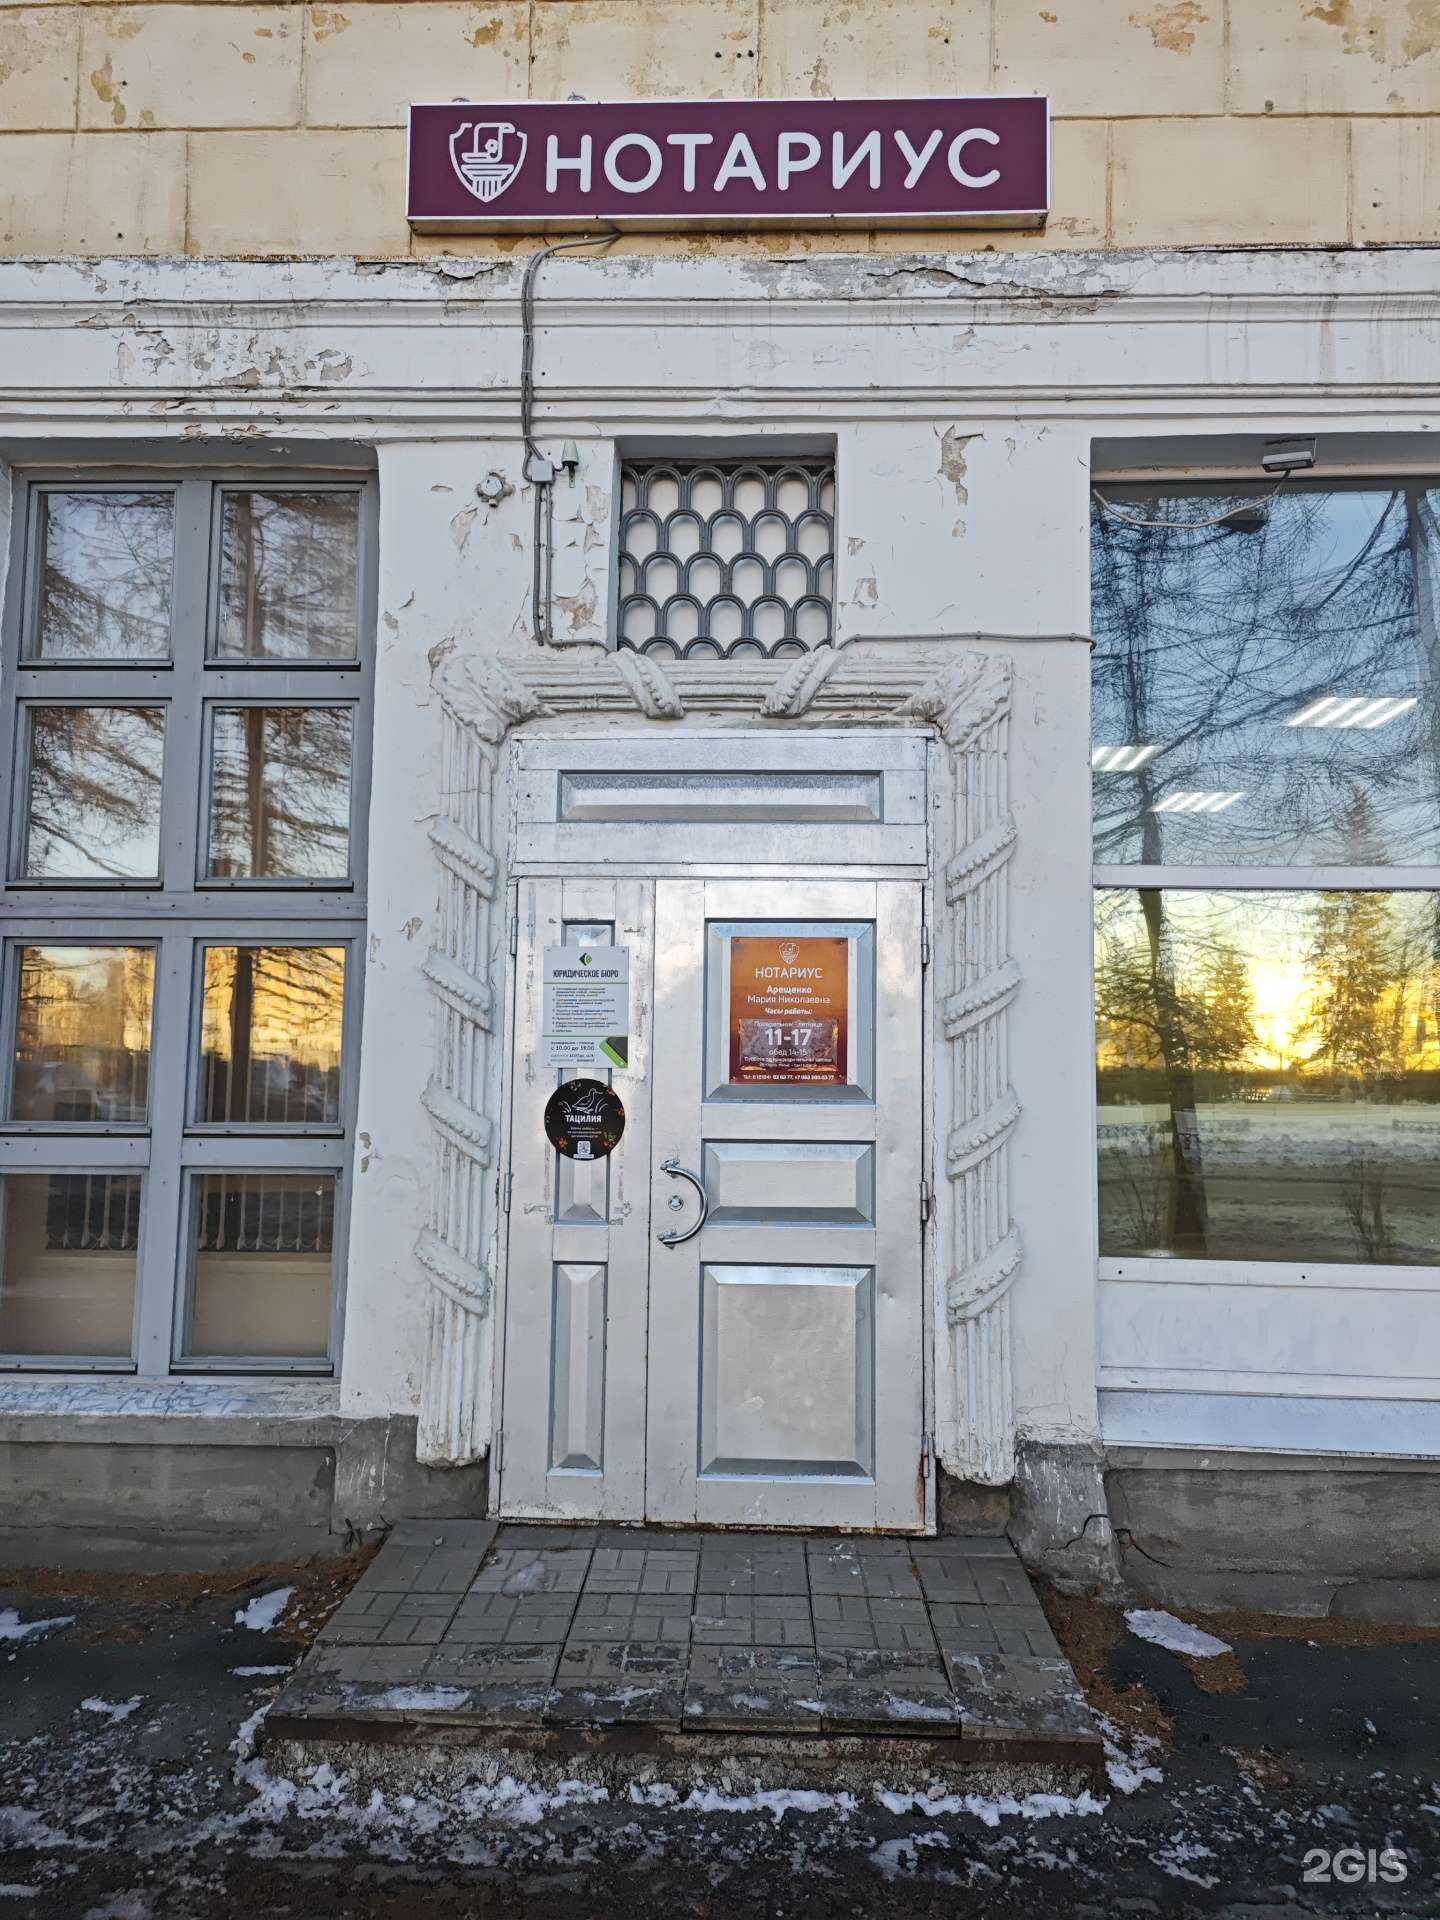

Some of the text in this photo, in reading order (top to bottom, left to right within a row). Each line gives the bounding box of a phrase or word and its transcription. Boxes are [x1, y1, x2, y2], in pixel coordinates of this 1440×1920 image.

[545, 127, 1001, 194] НОТАРИУС
[553, 969, 619, 978] ЮРИДИЧЕСКОЕ БЮРО
[755, 967, 823, 978] НОТАРИУС
[766, 985, 812, 994] Арещенко
[747, 995, 831, 1004] Мария Николаевна
[765, 1007, 783, 1015] Часы
[765, 1028, 812, 1046] 11-17
[769, 1048, 808, 1056] обед 14-15
[565, 1114, 602, 1124] ТАЦИЛИЯ
